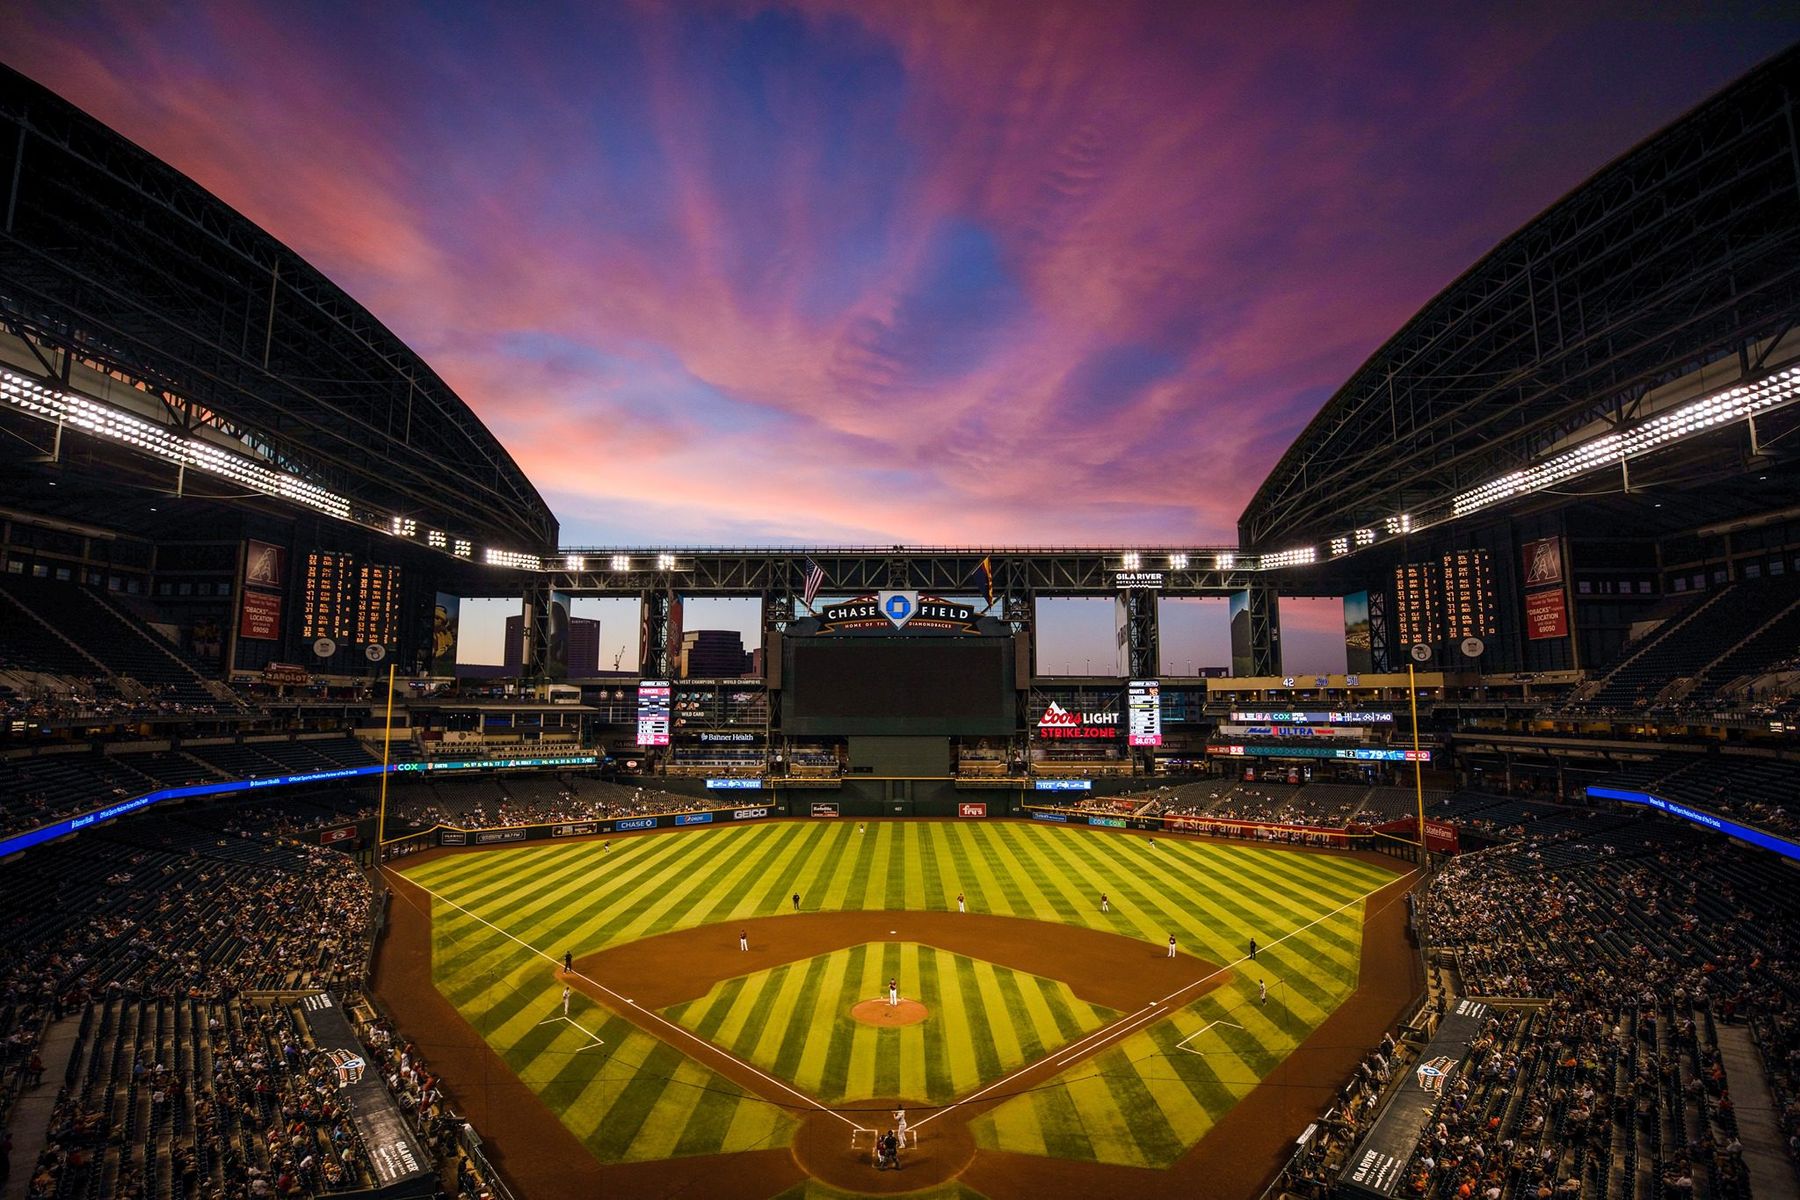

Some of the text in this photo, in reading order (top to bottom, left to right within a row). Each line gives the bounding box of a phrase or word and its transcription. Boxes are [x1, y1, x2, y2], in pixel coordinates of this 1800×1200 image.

[828, 606, 969, 619] CHASE FIELD
[1534, 612, 1558, 622] LOCATION
[1283, 678, 1294, 687] 42
[1041, 708, 1119, 724] Coors LIGHT
[1041, 728, 1115, 737] STRIKE ZONE
[735, 809, 766, 819] GEICO
[962, 805, 983, 815] fry's
[1426, 826, 1452, 838] State Farm
[396, 1141, 419, 1172] GILA RIVER
[1352, 1149, 1378, 1182] GILA RIVER
